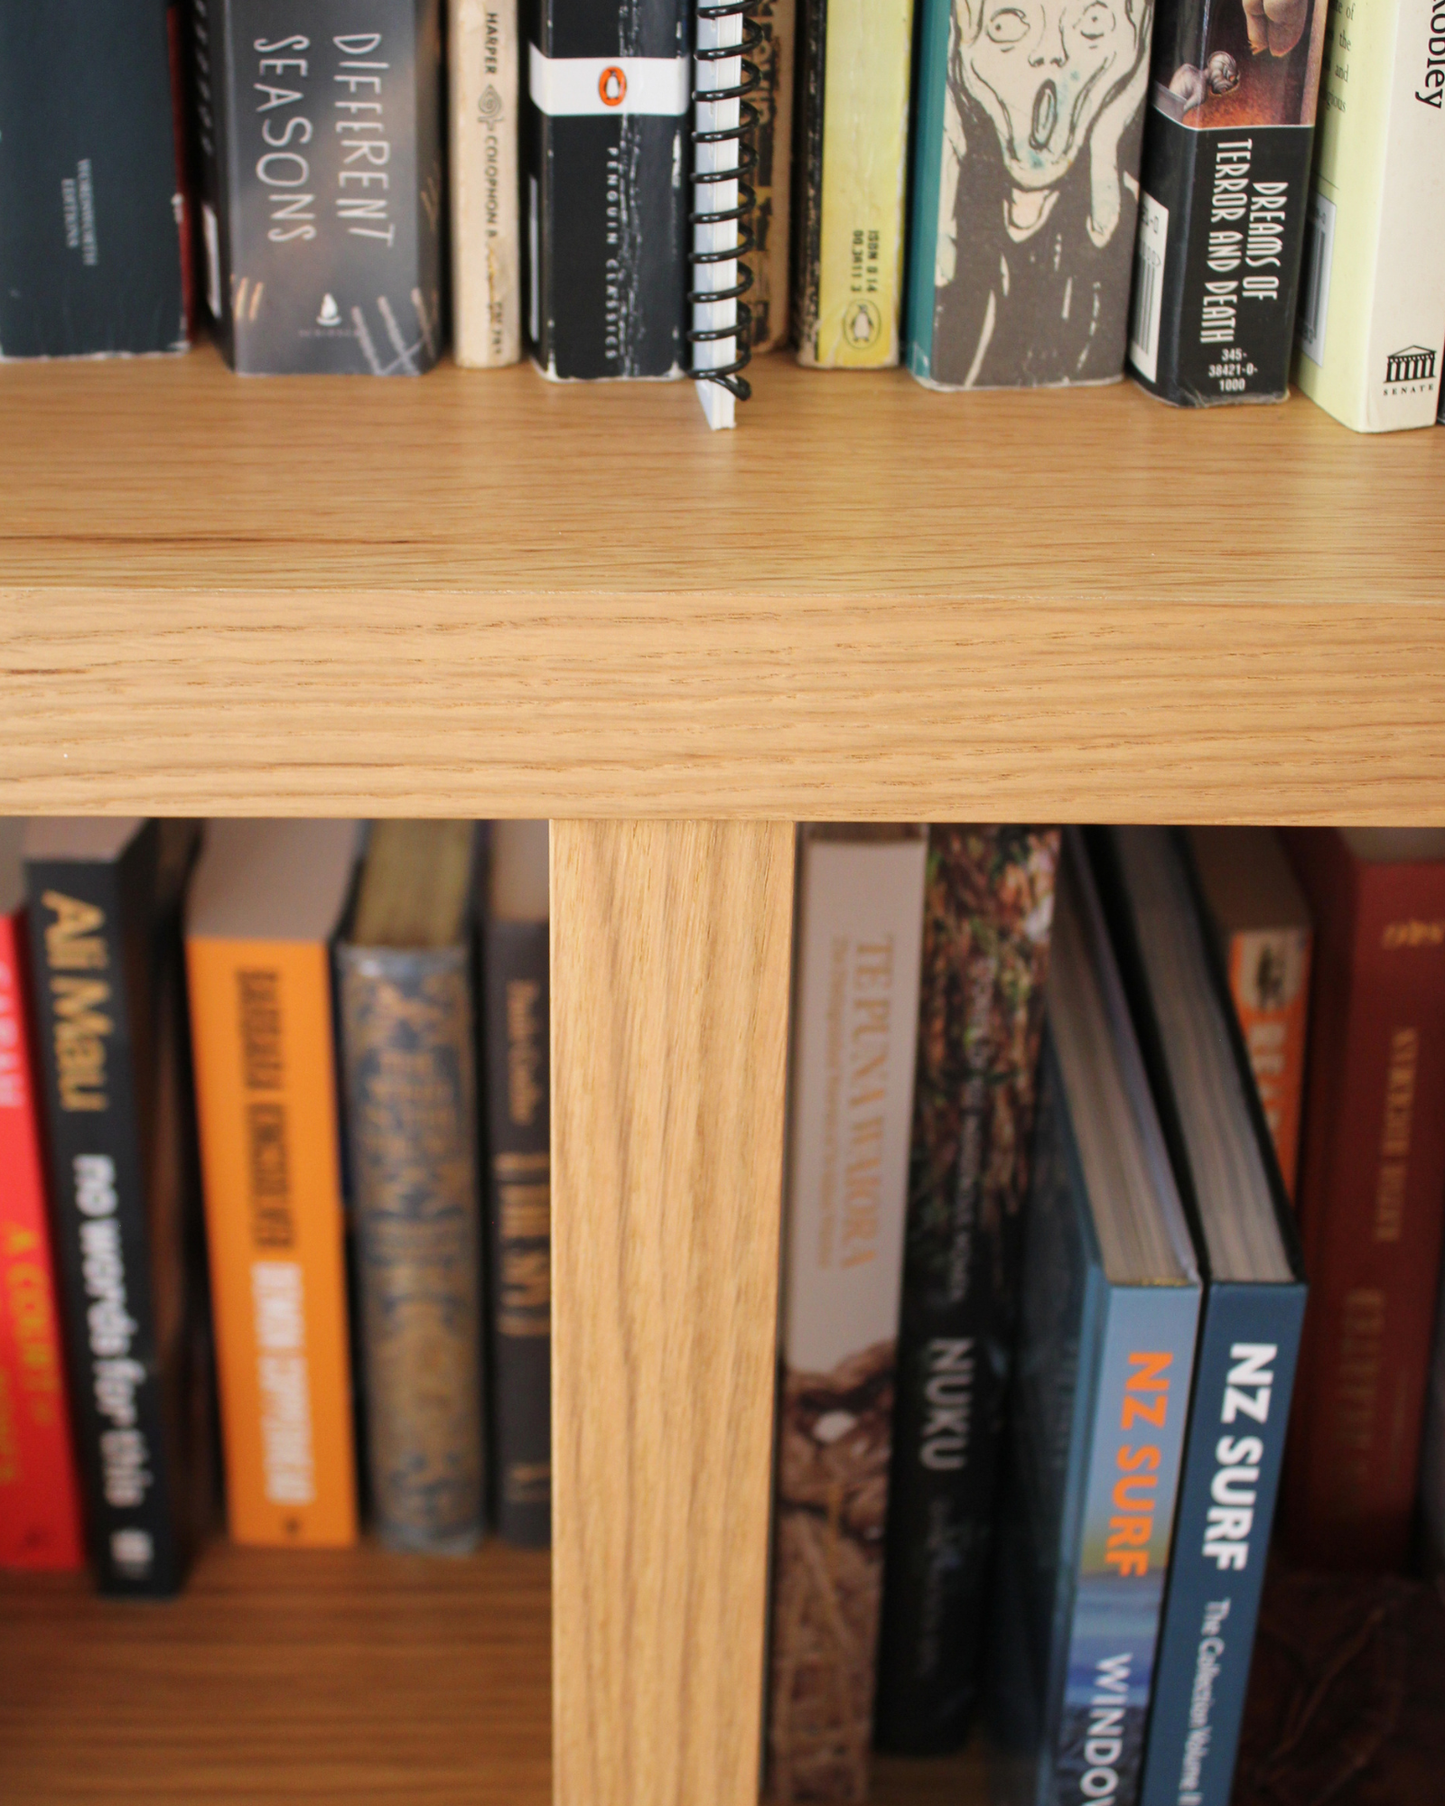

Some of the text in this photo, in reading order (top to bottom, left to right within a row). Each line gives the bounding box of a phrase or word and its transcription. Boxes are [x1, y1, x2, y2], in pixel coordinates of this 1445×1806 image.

[484, 12, 499, 75] HARPER
[1415, 0, 1445, 109] obley
[253, 34, 318, 244] SEASONS
[333, 32, 395, 248] DIFFERENT
[484, 135, 499, 223] COLOPHON
[604, 147, 619, 360] PENGUIN CLASSICS
[866, 278, 878, 292] 14
[867, 230, 880, 260] ISBN
[1200, 138, 1252, 344] TERROR AND DEATH
[1242, 182, 1289, 301] DREAMS OF
[1208, 362, 1258, 378] 38421-0-
[1219, 377, 1246, 392] 1000
[1221, 347, 1248, 362] 345-
[1383, 384, 1434, 396] SENATE
[42, 889, 115, 1112] Ali Mau
[854, 932, 896, 991] TE
[849, 1001, 892, 1107] PUNA
[72, 1153, 154, 1508] no words for this
[919, 1335, 974, 1473] NUKU
[1221, 1341, 1278, 1424] NZ
[1105, 1351, 1174, 1577] NZ SURF
[1202, 1435, 1264, 1571] SURF
[1202, 1597, 1231, 1636] The
[1189, 1636, 1225, 1729] Collection
[1179, 1726, 1212, 1791] Volume
